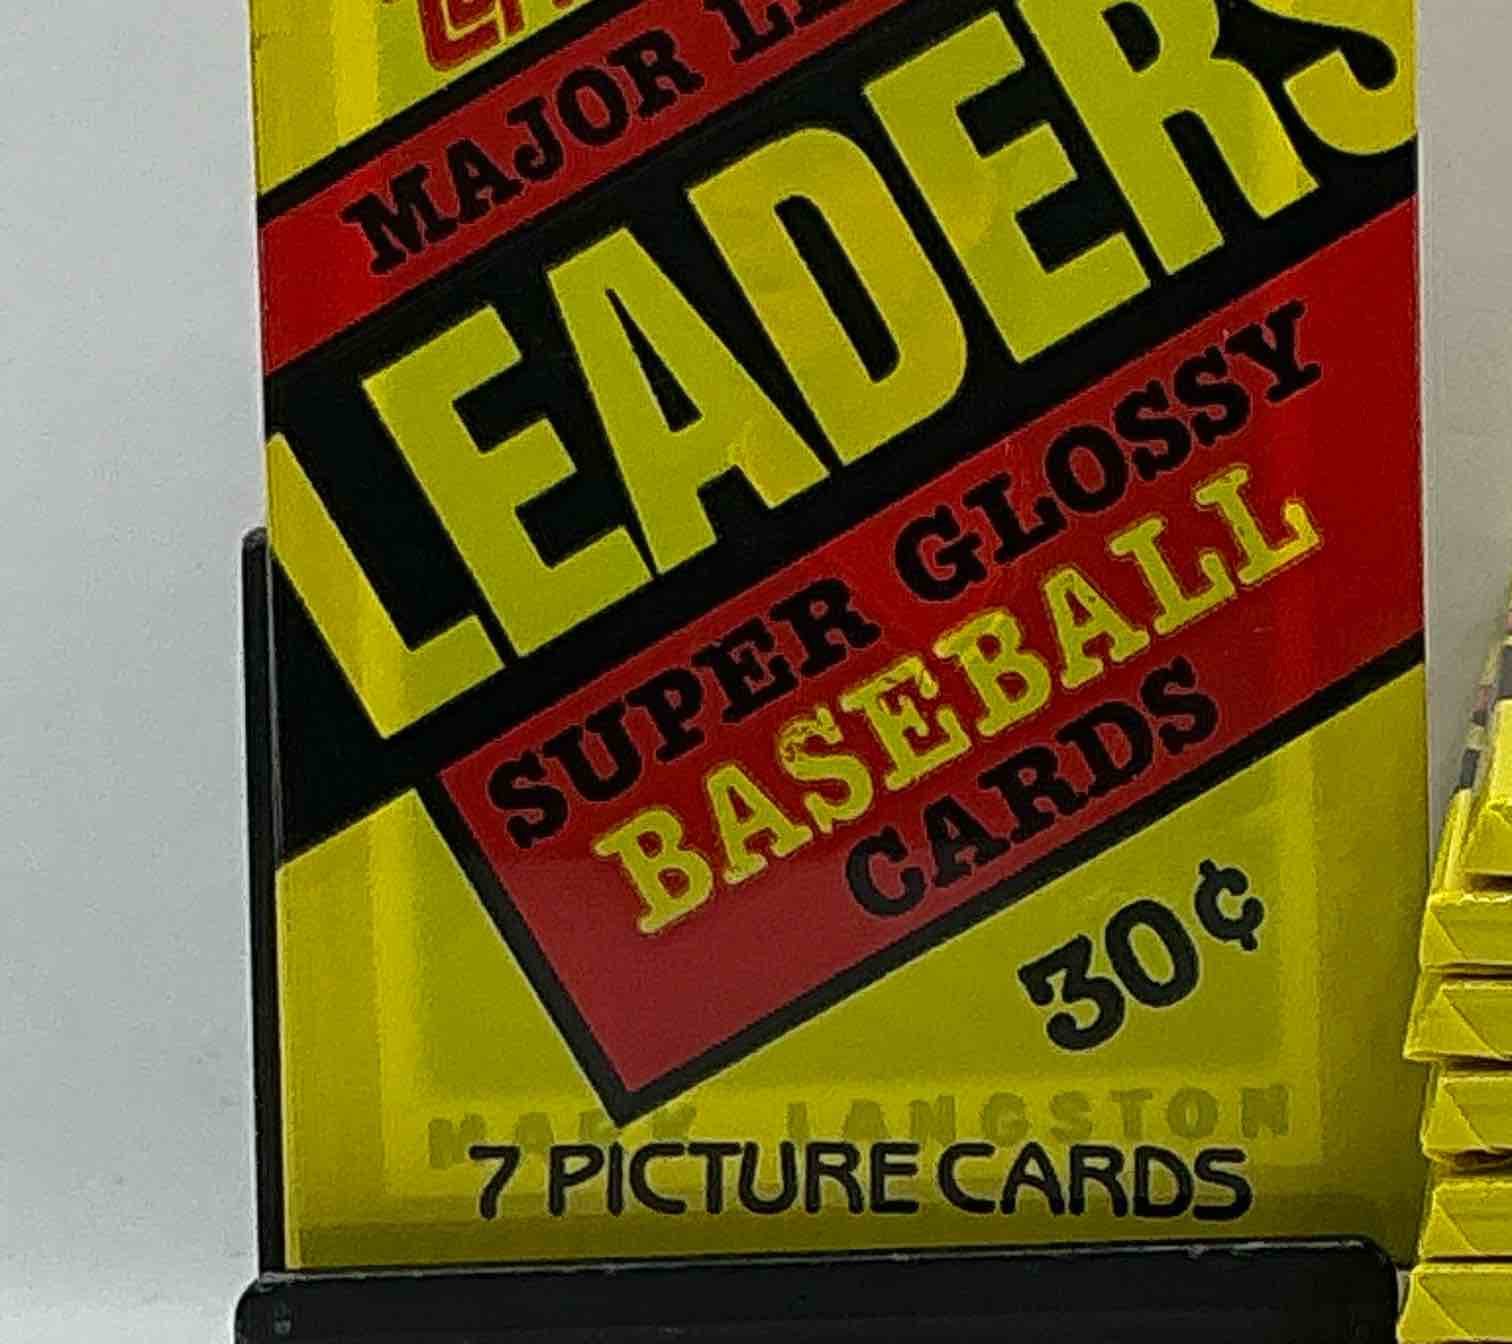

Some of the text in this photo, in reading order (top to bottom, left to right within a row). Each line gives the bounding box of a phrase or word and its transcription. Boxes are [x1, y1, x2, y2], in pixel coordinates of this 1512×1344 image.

[341, 29, 705, 273] MAJOR
[486, 301, 1324, 848] SUPER GLOSSY
[594, 464, 1322, 936] BASEBALL
[845, 657, 1221, 919] CARDS
[1018, 858, 1267, 1052] 30¢
[469, 1141, 1254, 1221] 7 PICTURE CARDS
